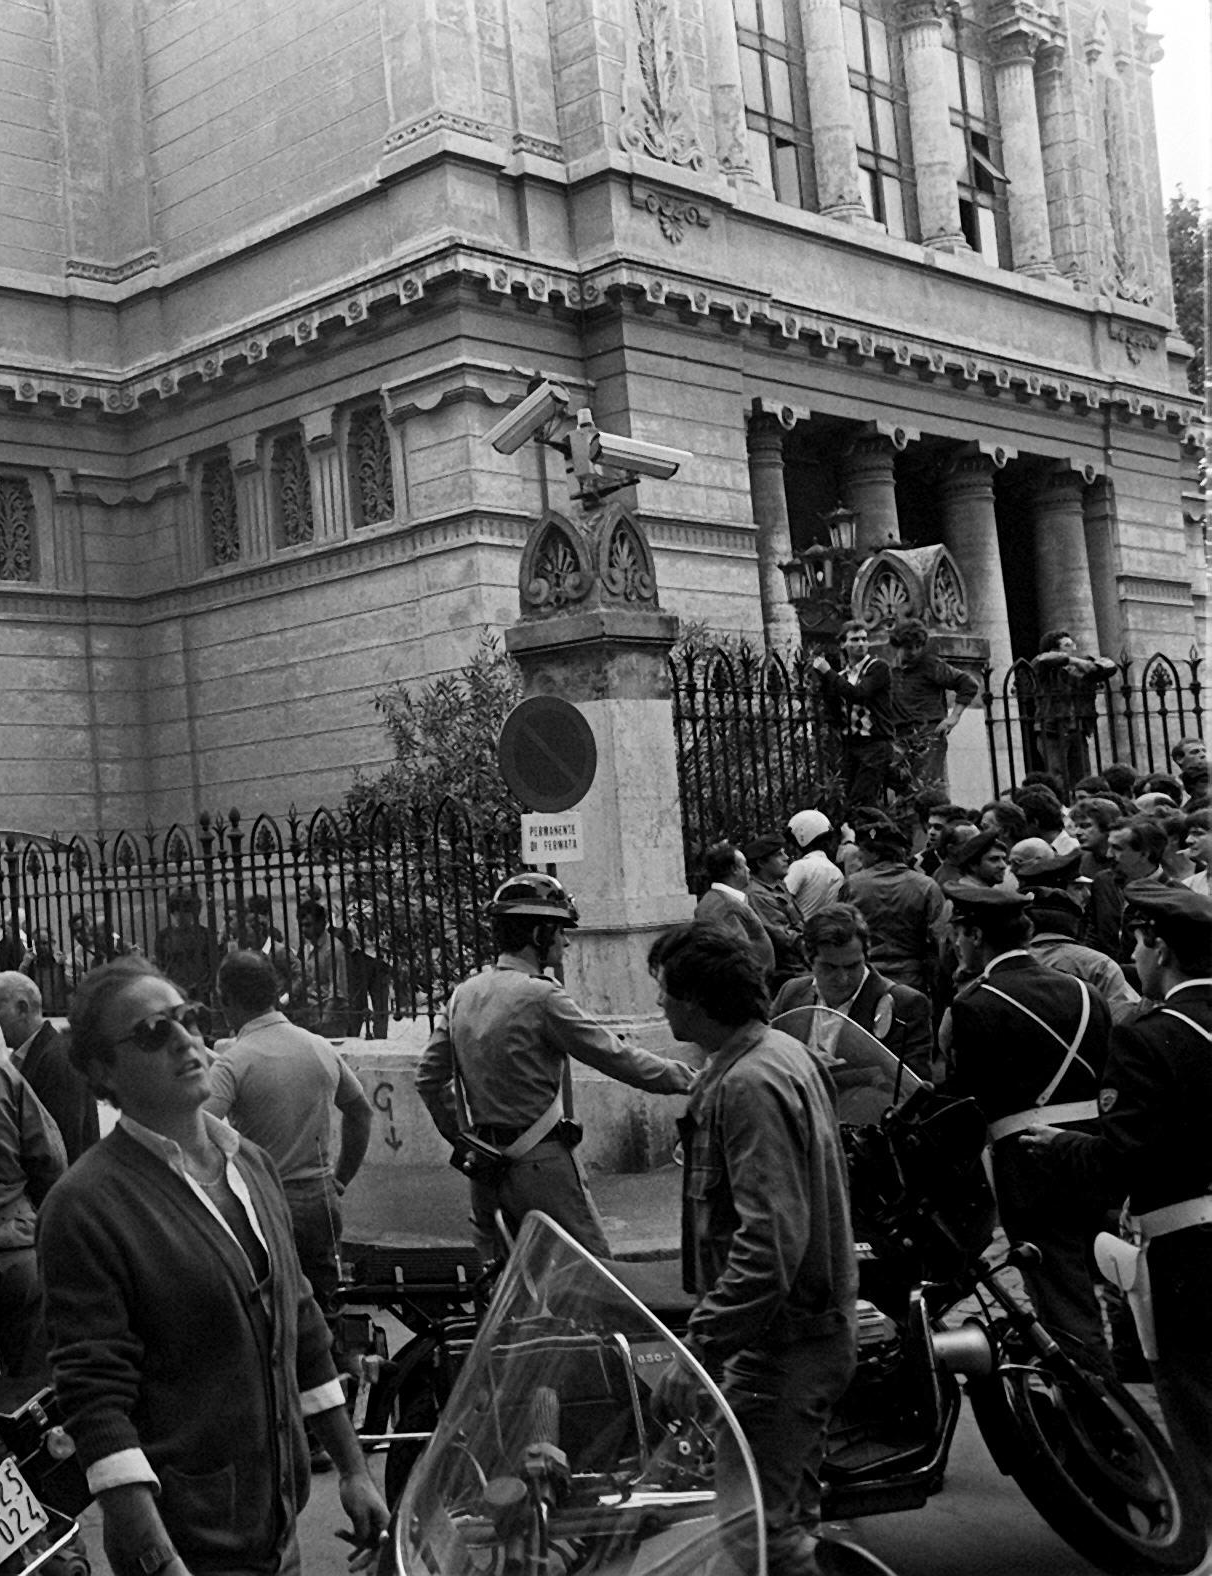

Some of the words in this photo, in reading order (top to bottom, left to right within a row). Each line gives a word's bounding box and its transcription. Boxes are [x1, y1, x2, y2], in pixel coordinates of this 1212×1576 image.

[529, 824, 576, 837] PERMANENTE
[530, 841, 538, 852] DI
[543, 839, 578, 851] FERMATA
